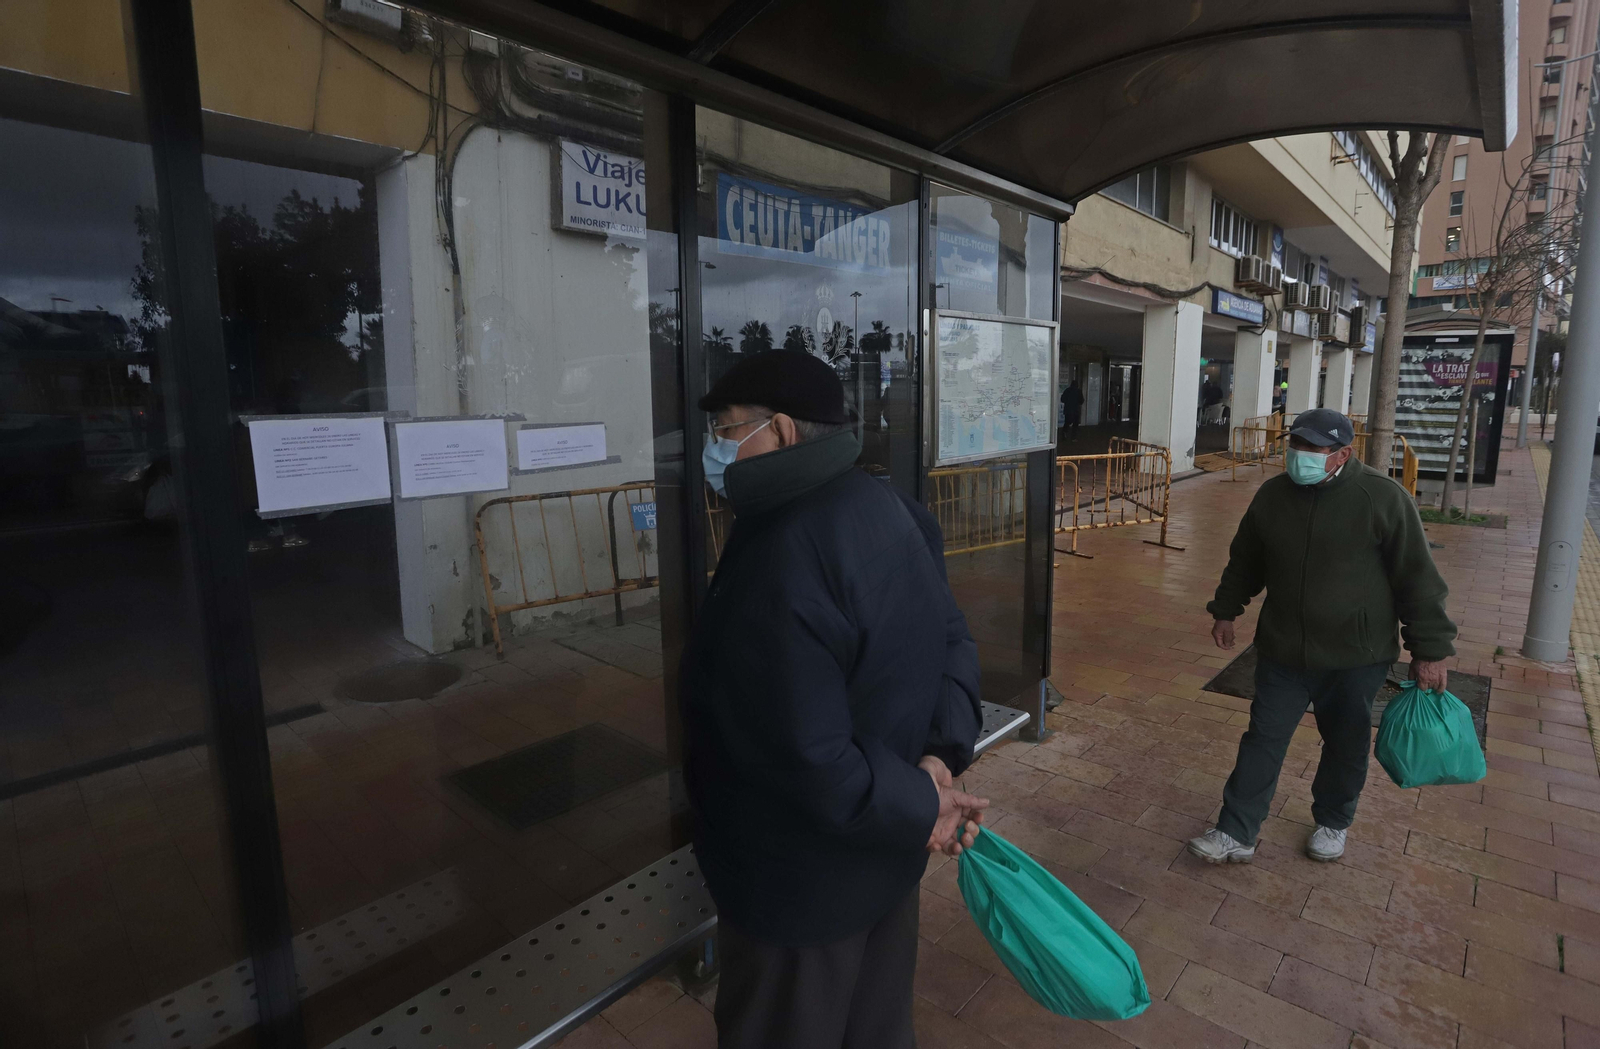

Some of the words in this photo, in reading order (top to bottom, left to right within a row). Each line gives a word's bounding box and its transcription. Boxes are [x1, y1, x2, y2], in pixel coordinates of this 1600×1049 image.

[725, 185, 891, 268] CEUTA-TANGER
[939, 231, 996, 254] BILLETES-TICKETS
[1432, 363, 1444, 373] LA
[1446, 363, 1477, 373] TRAT
